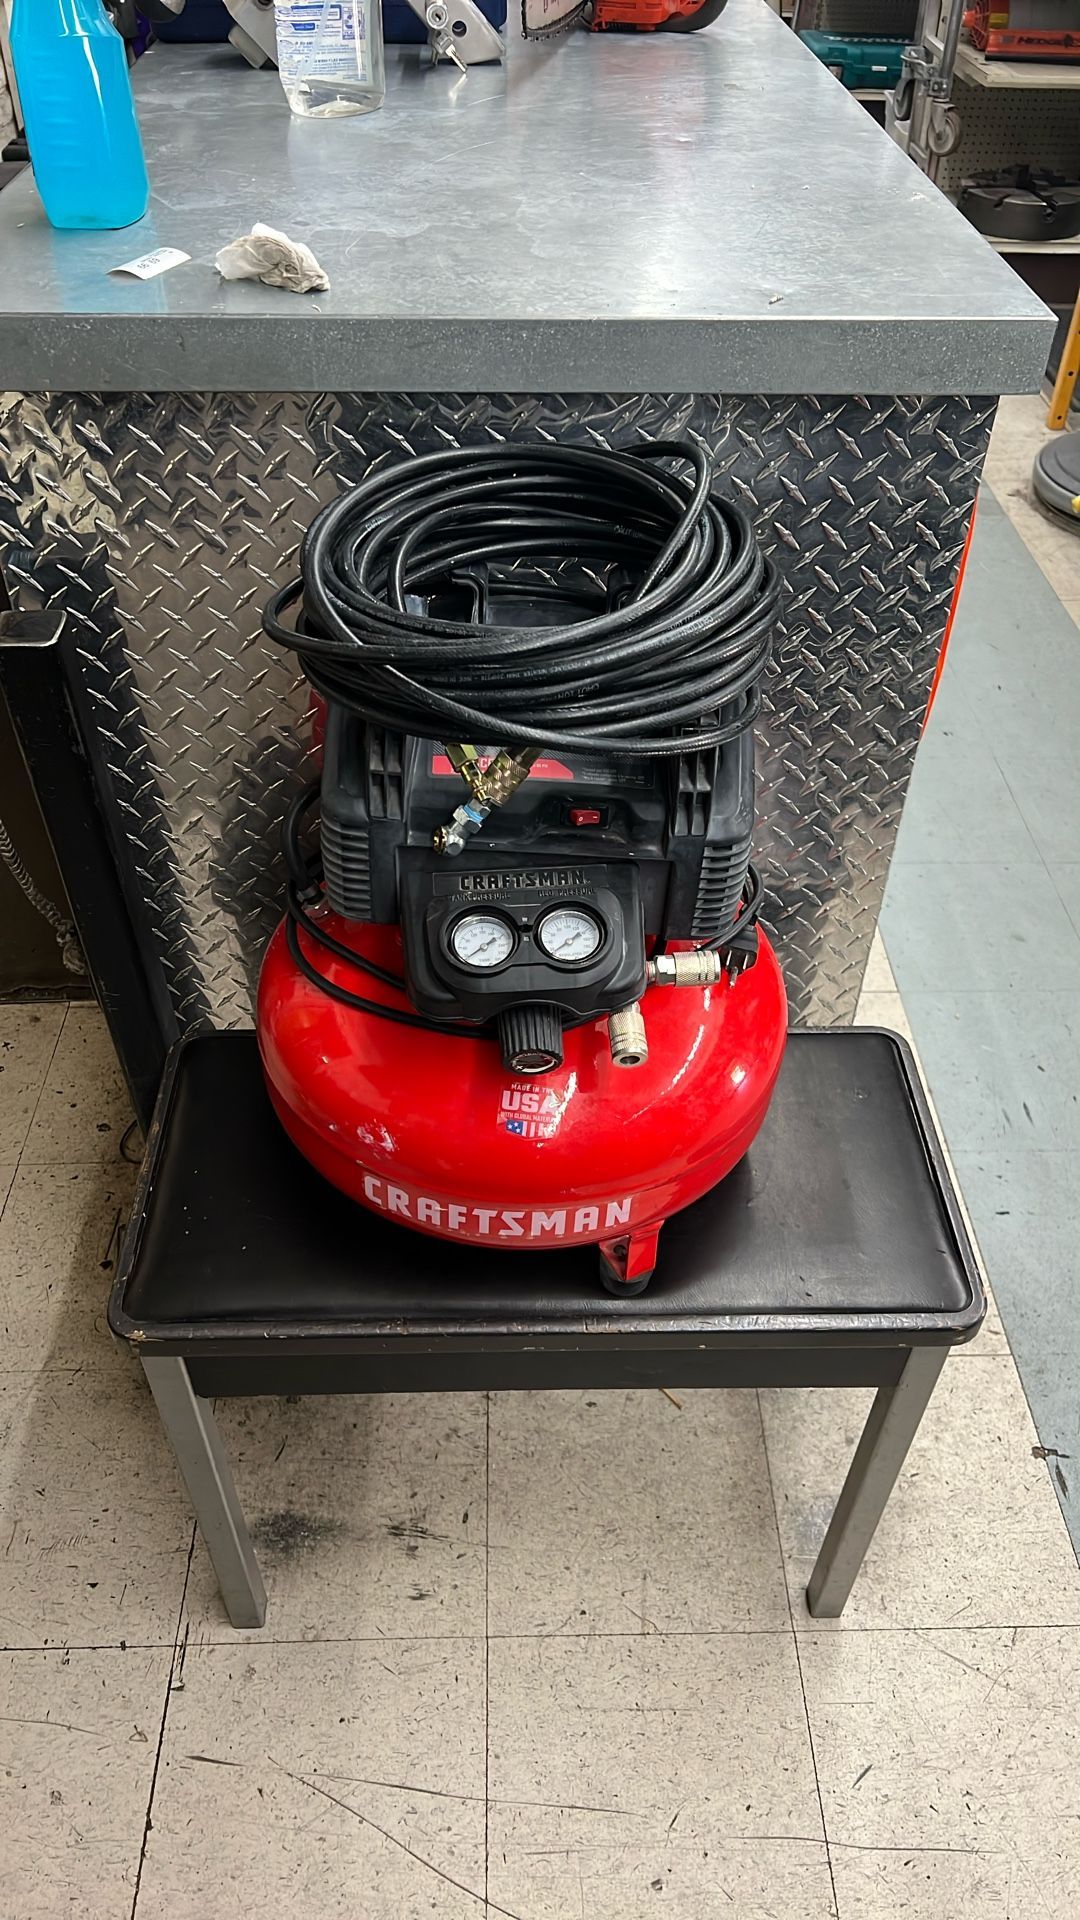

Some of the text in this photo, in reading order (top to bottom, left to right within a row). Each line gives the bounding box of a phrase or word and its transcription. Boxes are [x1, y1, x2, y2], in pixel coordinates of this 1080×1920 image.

[460, 869, 586, 890] CRAFTSMAN
[511, 1083, 531, 1091] MADE
[501, 1089, 557, 1115] USA
[363, 1175, 633, 1237] CRAFTSMAN
